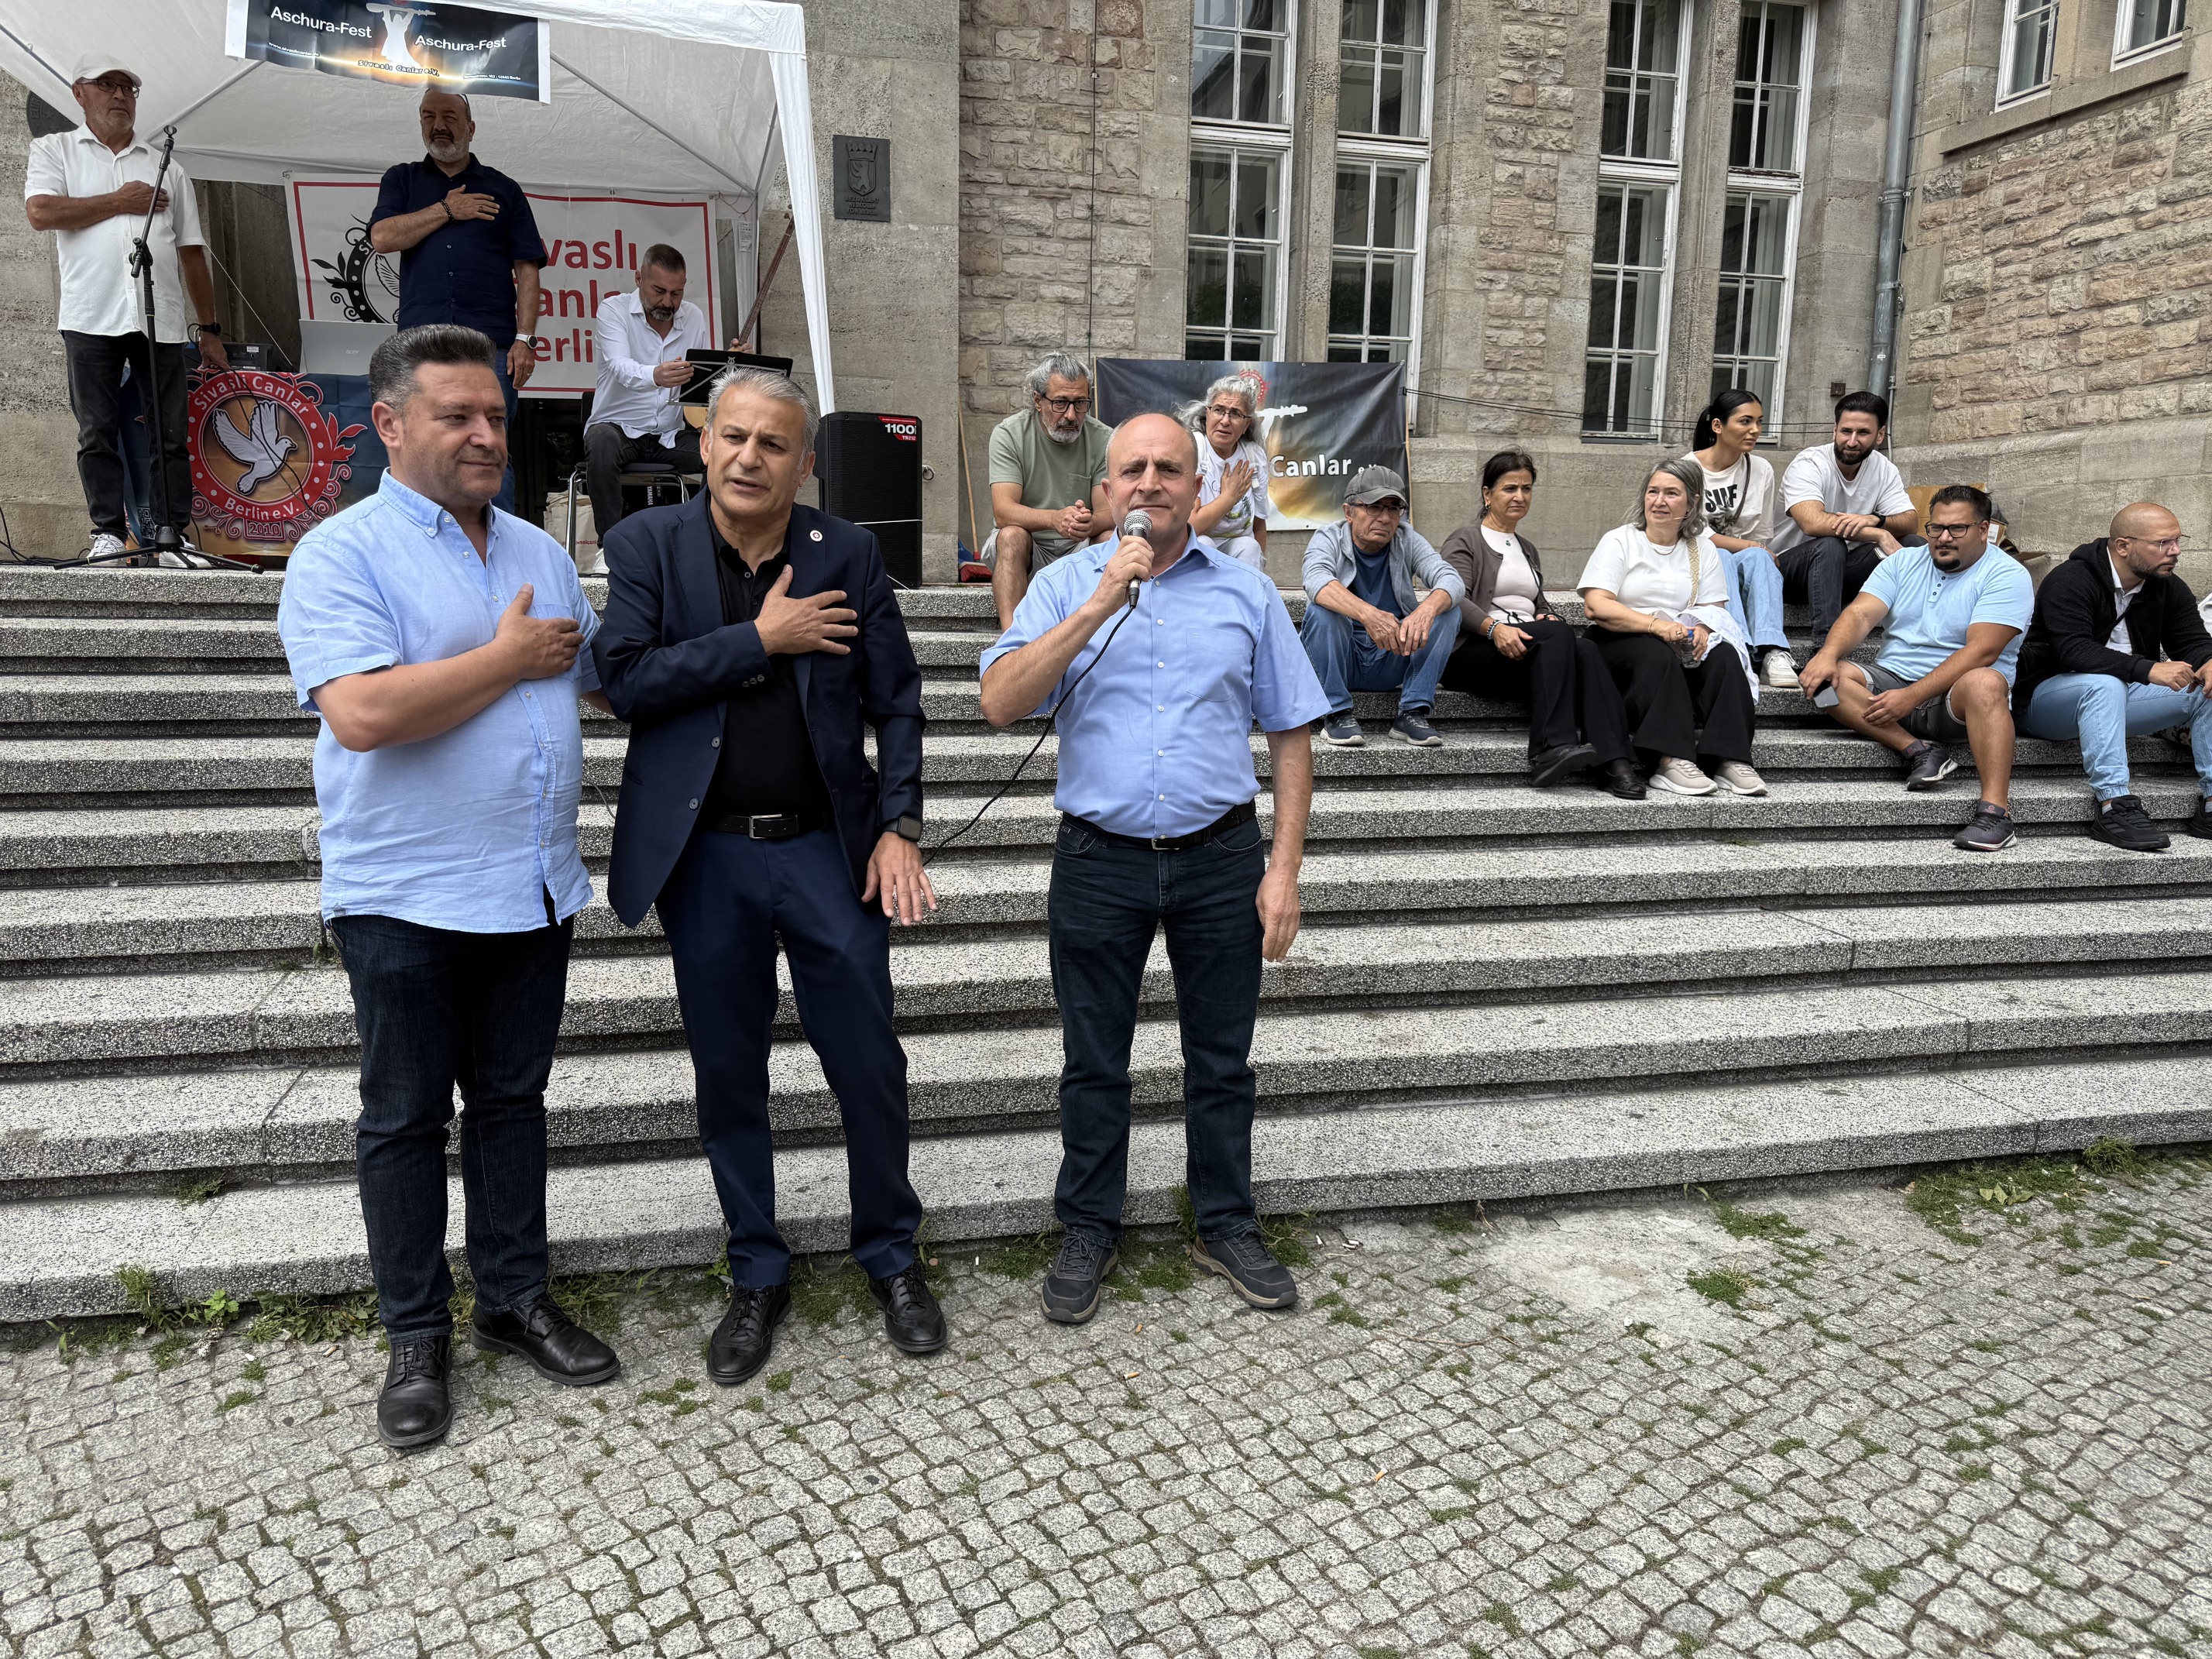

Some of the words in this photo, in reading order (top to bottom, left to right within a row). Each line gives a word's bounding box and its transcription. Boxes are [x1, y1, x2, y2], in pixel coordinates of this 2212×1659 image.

[270, 5, 373, 39] Aschura-Fest
[414, 35, 507, 51] Aschura-Fest
[541, 228, 637, 270] vaslı
[534, 328, 593, 363] erli
[252, 376, 310, 415] Canlar
[1269, 454, 1352, 478] Canlar
[224, 497, 270, 521] Berlin
[273, 502, 301, 518] e.V.
[249, 523, 280, 536] 2010
